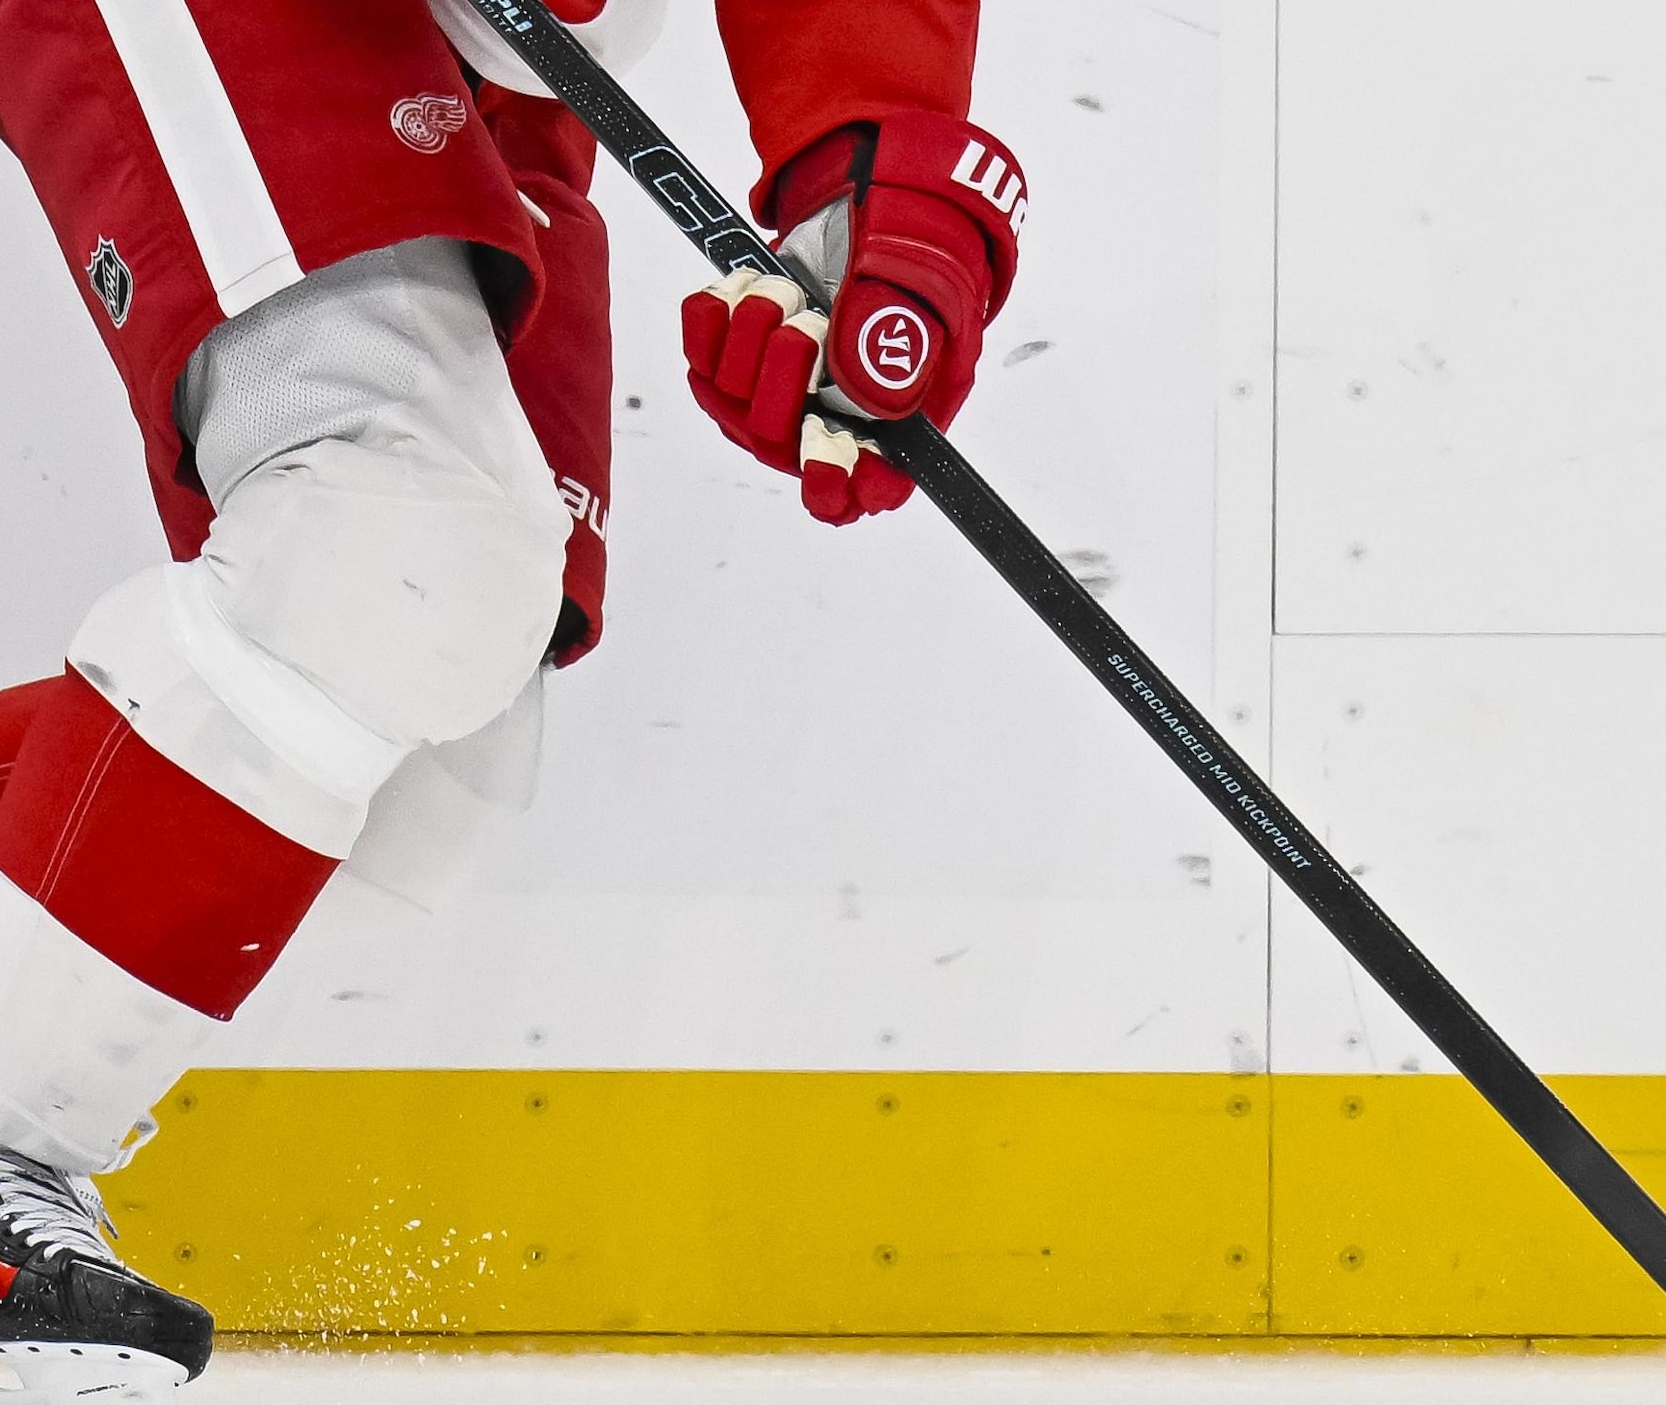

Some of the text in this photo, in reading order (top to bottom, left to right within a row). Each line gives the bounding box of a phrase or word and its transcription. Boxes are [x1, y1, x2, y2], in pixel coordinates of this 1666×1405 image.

[1106, 652, 1312, 870] SUPERCHARGED MID KICKPOINT
